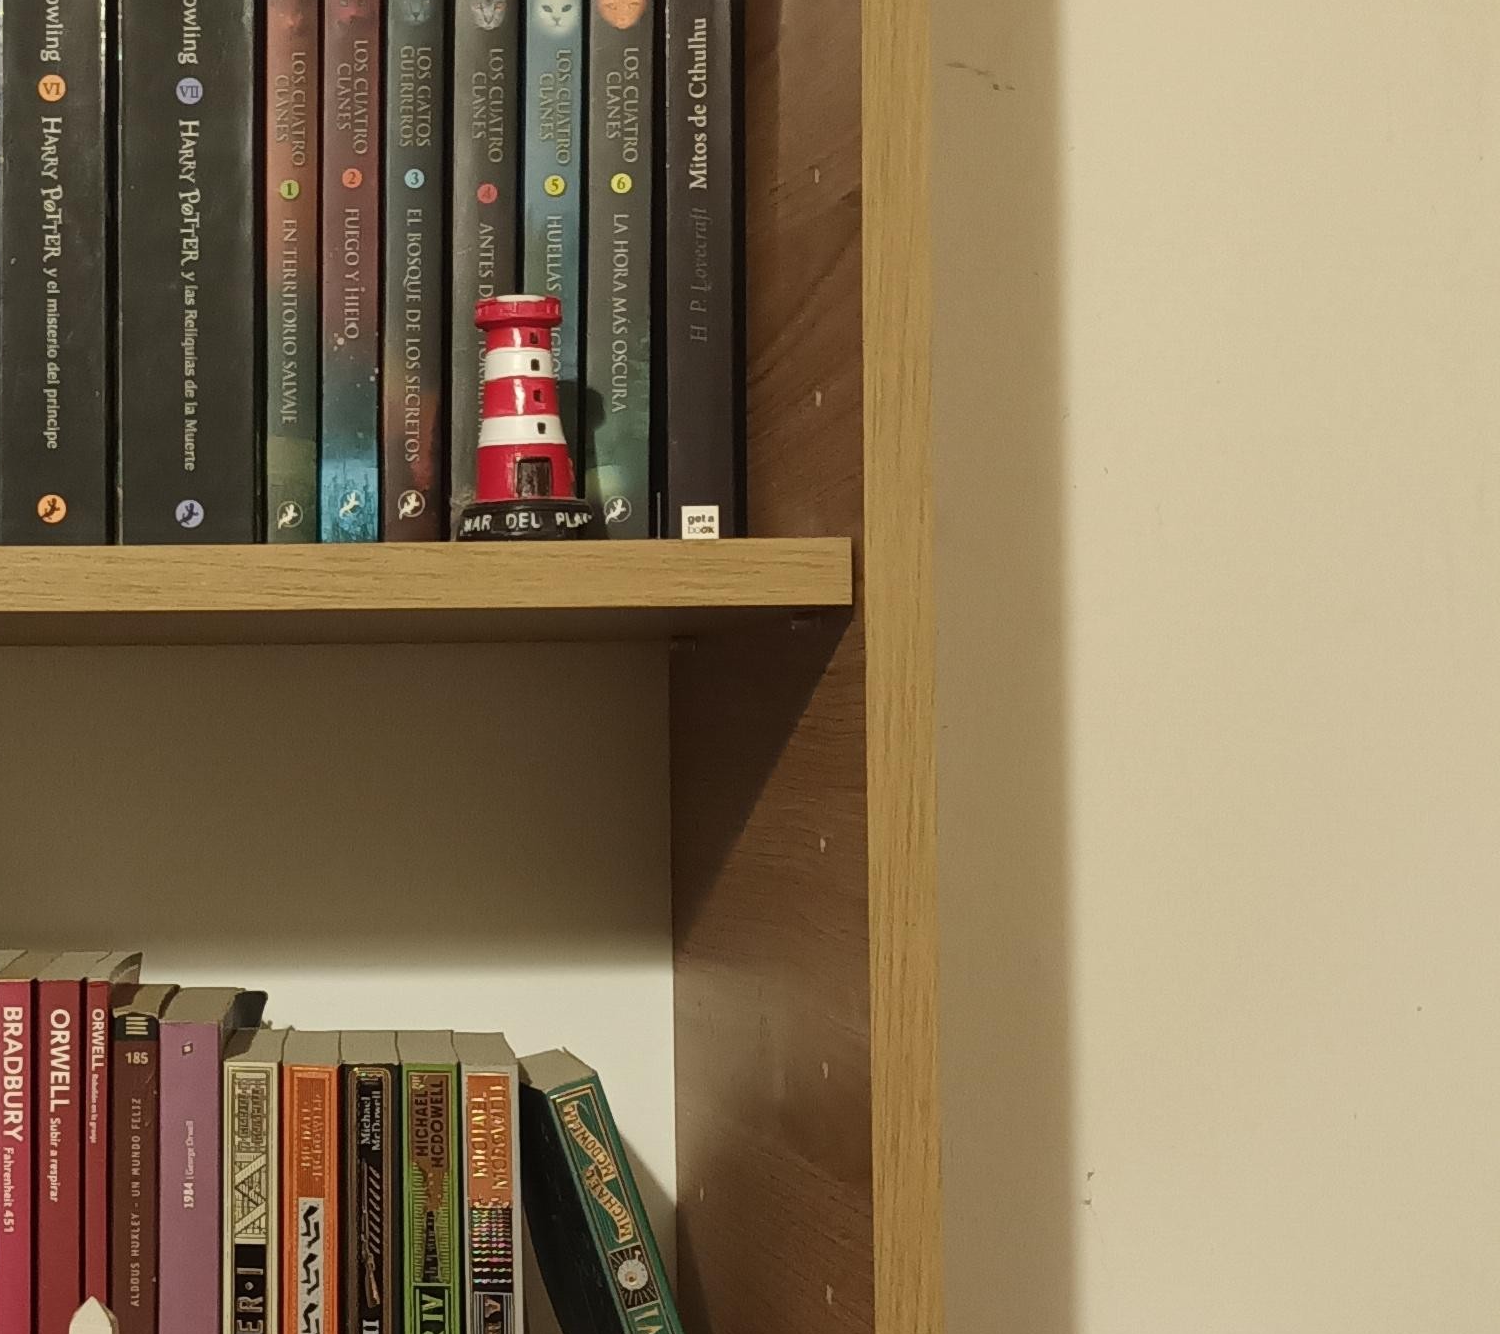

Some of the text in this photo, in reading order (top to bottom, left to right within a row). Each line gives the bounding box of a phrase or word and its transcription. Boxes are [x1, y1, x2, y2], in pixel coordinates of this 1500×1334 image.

[689, 17, 707, 190] Mitos de Cthulhu
[178, 118, 201, 183] HARRY
[184, 284, 198, 306] las
[182, 308, 197, 376] Reliquias
[183, 419, 197, 471] Muerte
[50, 1008, 71, 1113] ORWELL
[91, 1008, 105, 1072] ORWELL
[125, 1052, 149, 1065] 185
[2, 1006, 24, 1233] BRADBURY Fahrenheit 451
[49, 1117, 61, 1147] Subir
[130, 1135, 142, 1176] MUNDO
[47, 1159, 60, 1203] respirar
[130, 1181, 142, 1197] UN
[183, 1182, 195, 1208] 1984
[130, 1213, 142, 1257] HUXLEY
[130, 1263, 142, 1308] ALDOUS
[422, 1291, 446, 1325] IV
